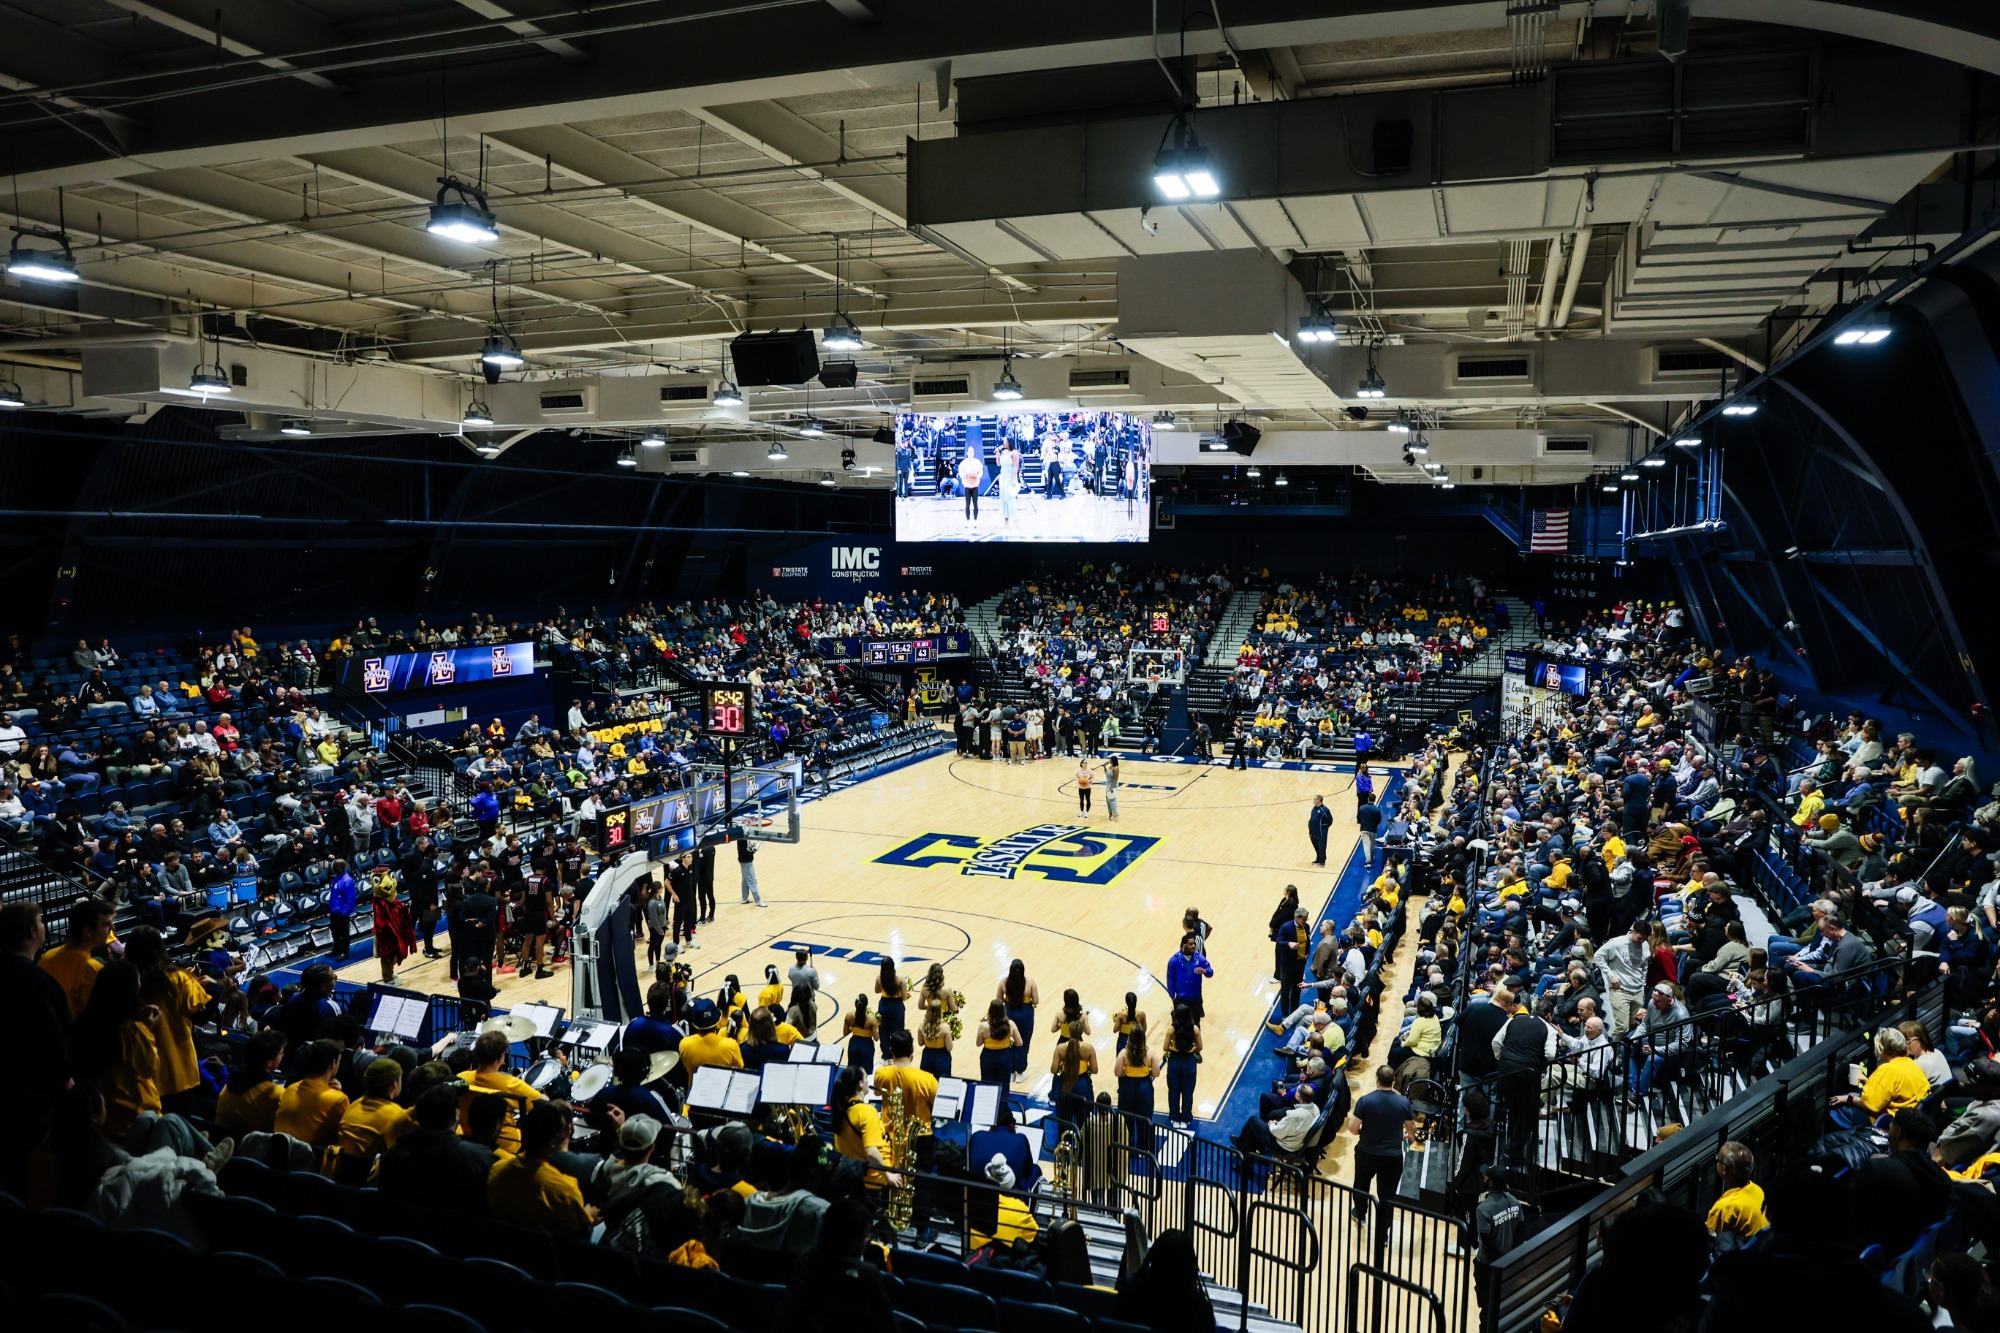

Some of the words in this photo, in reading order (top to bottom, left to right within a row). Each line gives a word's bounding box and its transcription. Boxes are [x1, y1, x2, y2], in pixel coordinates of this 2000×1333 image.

[831, 546, 880, 570] IMC
[1153, 619, 1167, 631] 30
[891, 644, 911, 652] 15:42
[918, 649, 927, 657] 43
[714, 690, 743, 706] 15:42
[714, 705, 740, 731] 30
[606, 811, 626, 827] 15:42
[609, 826, 623, 845] 30
[964, 823, 1086, 879] LASALLE
